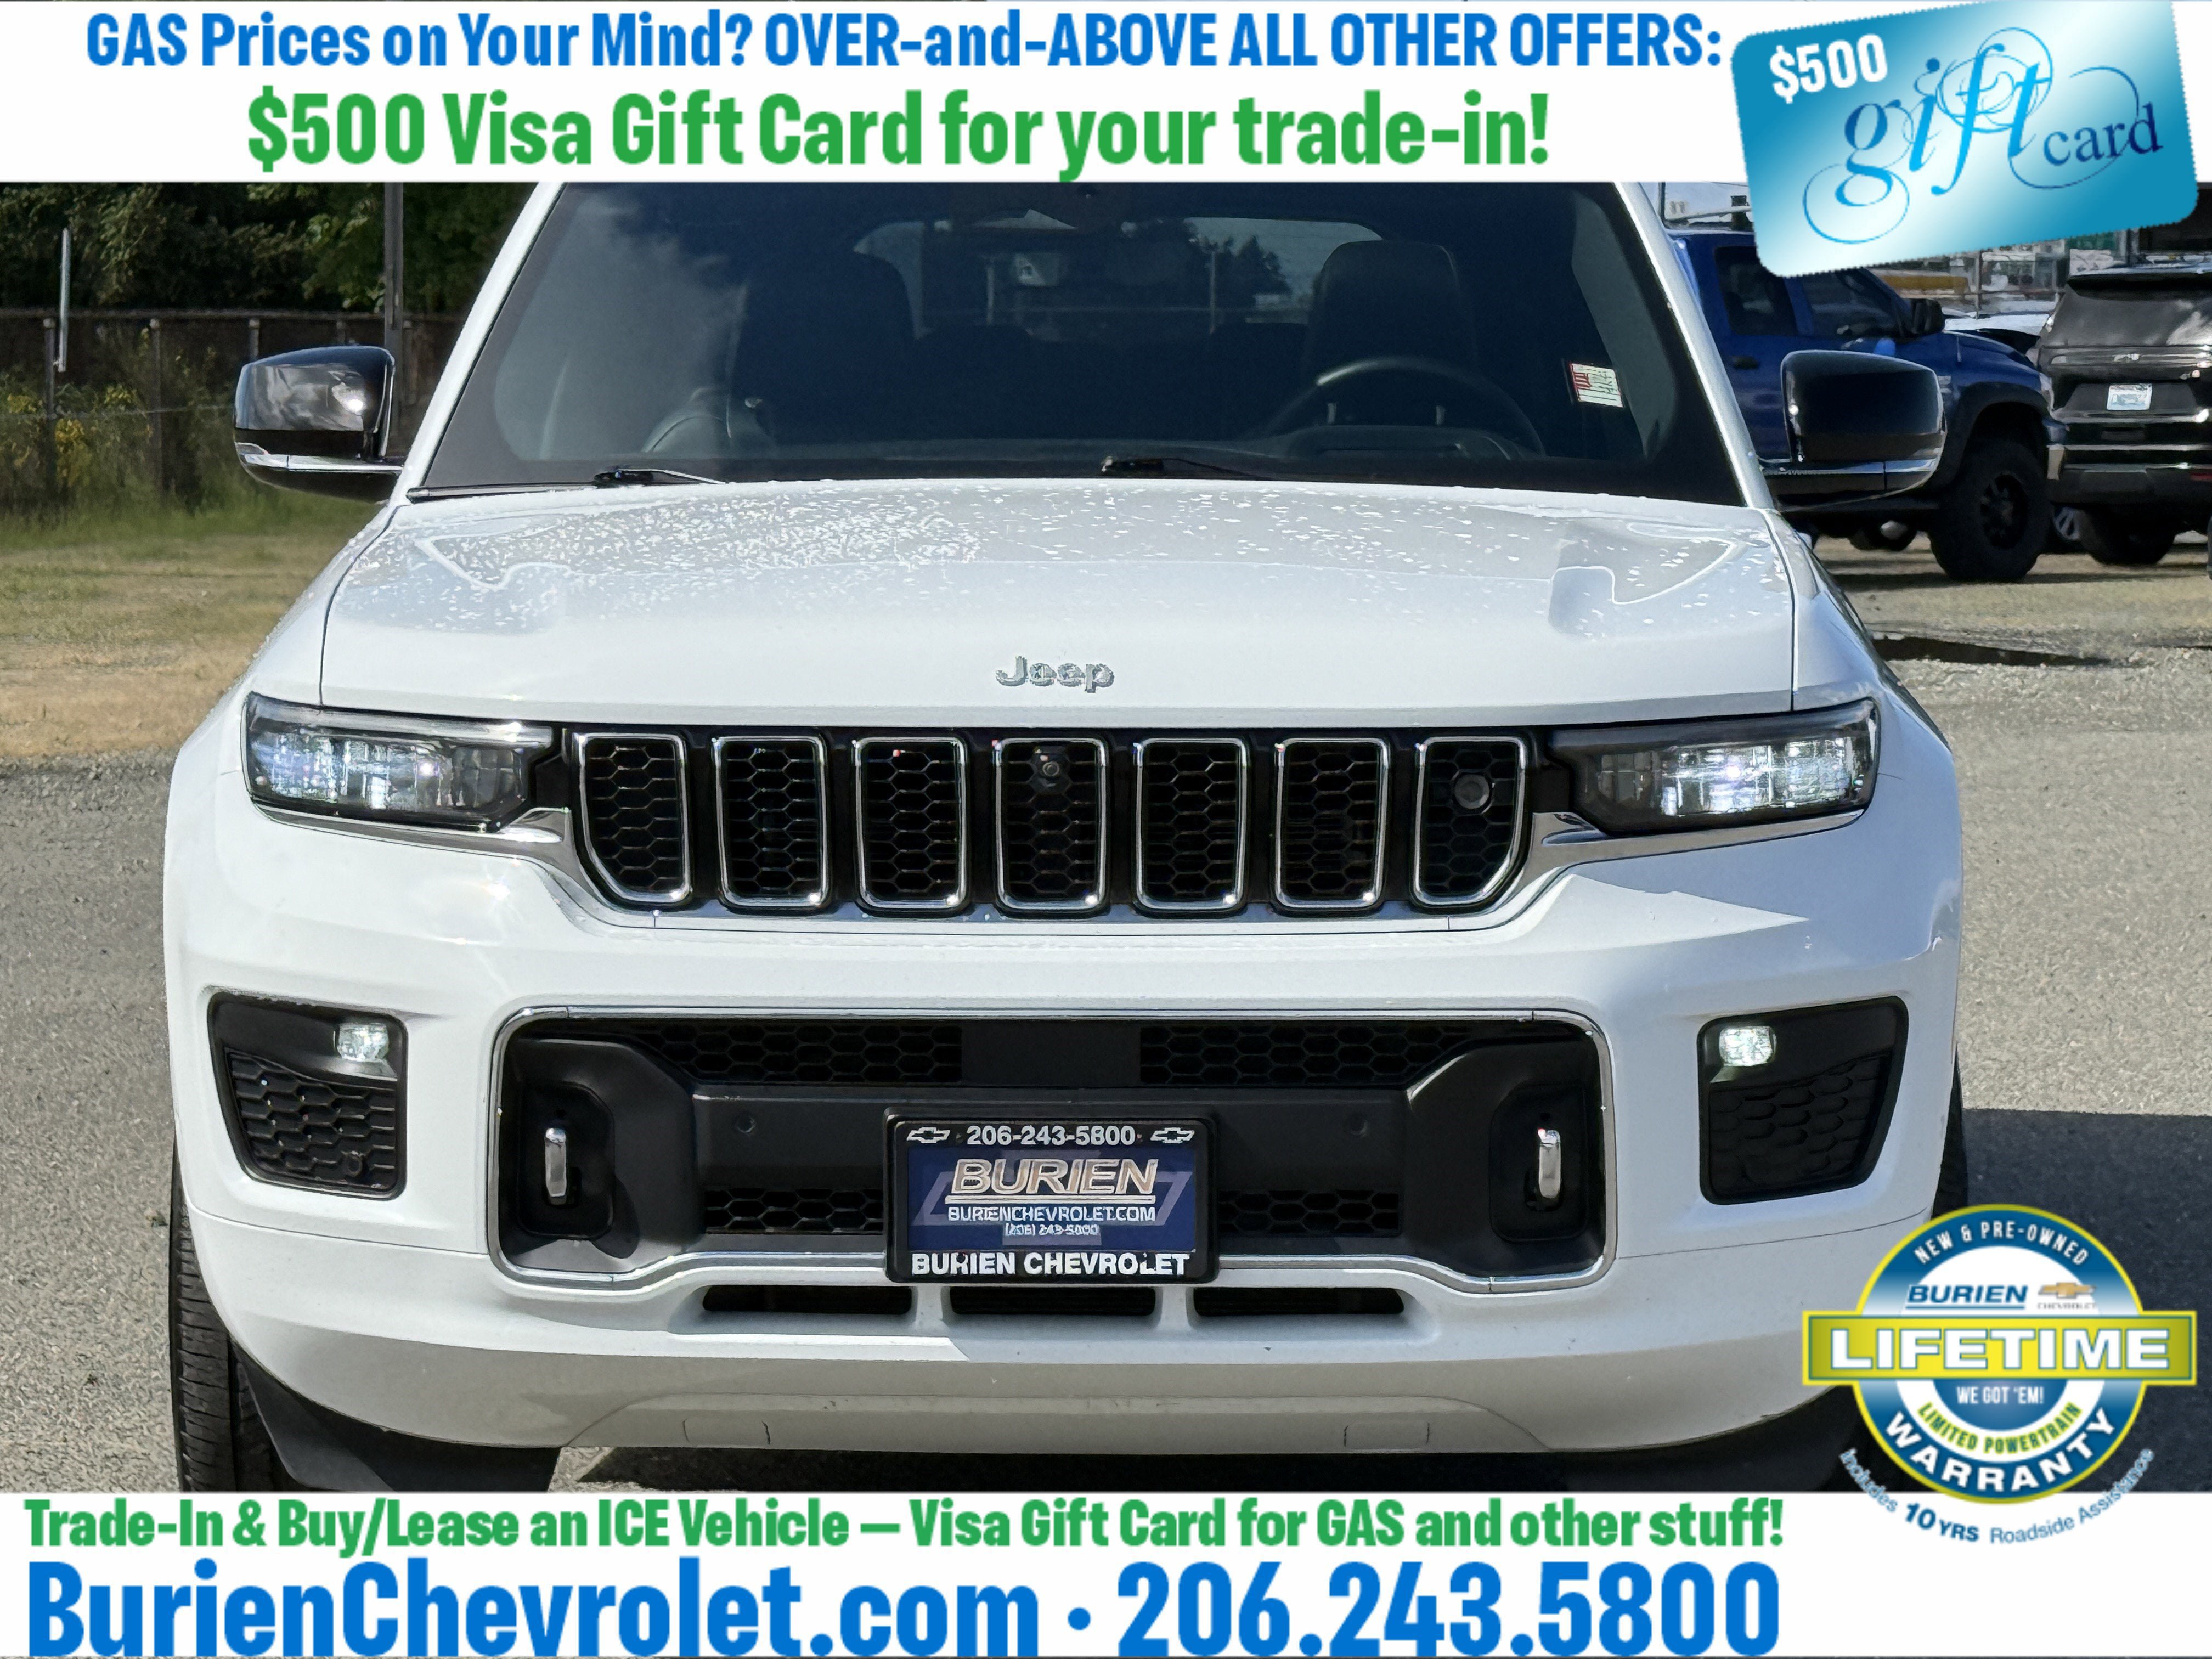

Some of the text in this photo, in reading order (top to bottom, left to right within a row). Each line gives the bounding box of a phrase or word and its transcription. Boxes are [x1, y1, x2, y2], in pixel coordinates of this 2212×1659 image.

[996, 656, 1115, 693] Jeep
[966, 1125, 1136, 1146] 206-243-5800
[951, 1158, 1159, 1195] BURIEN
[947, 1207, 1156, 1222] BURIENCHEVROLET.COM
[911, 1252, 1190, 1276] BURIEN CHEVROLET
